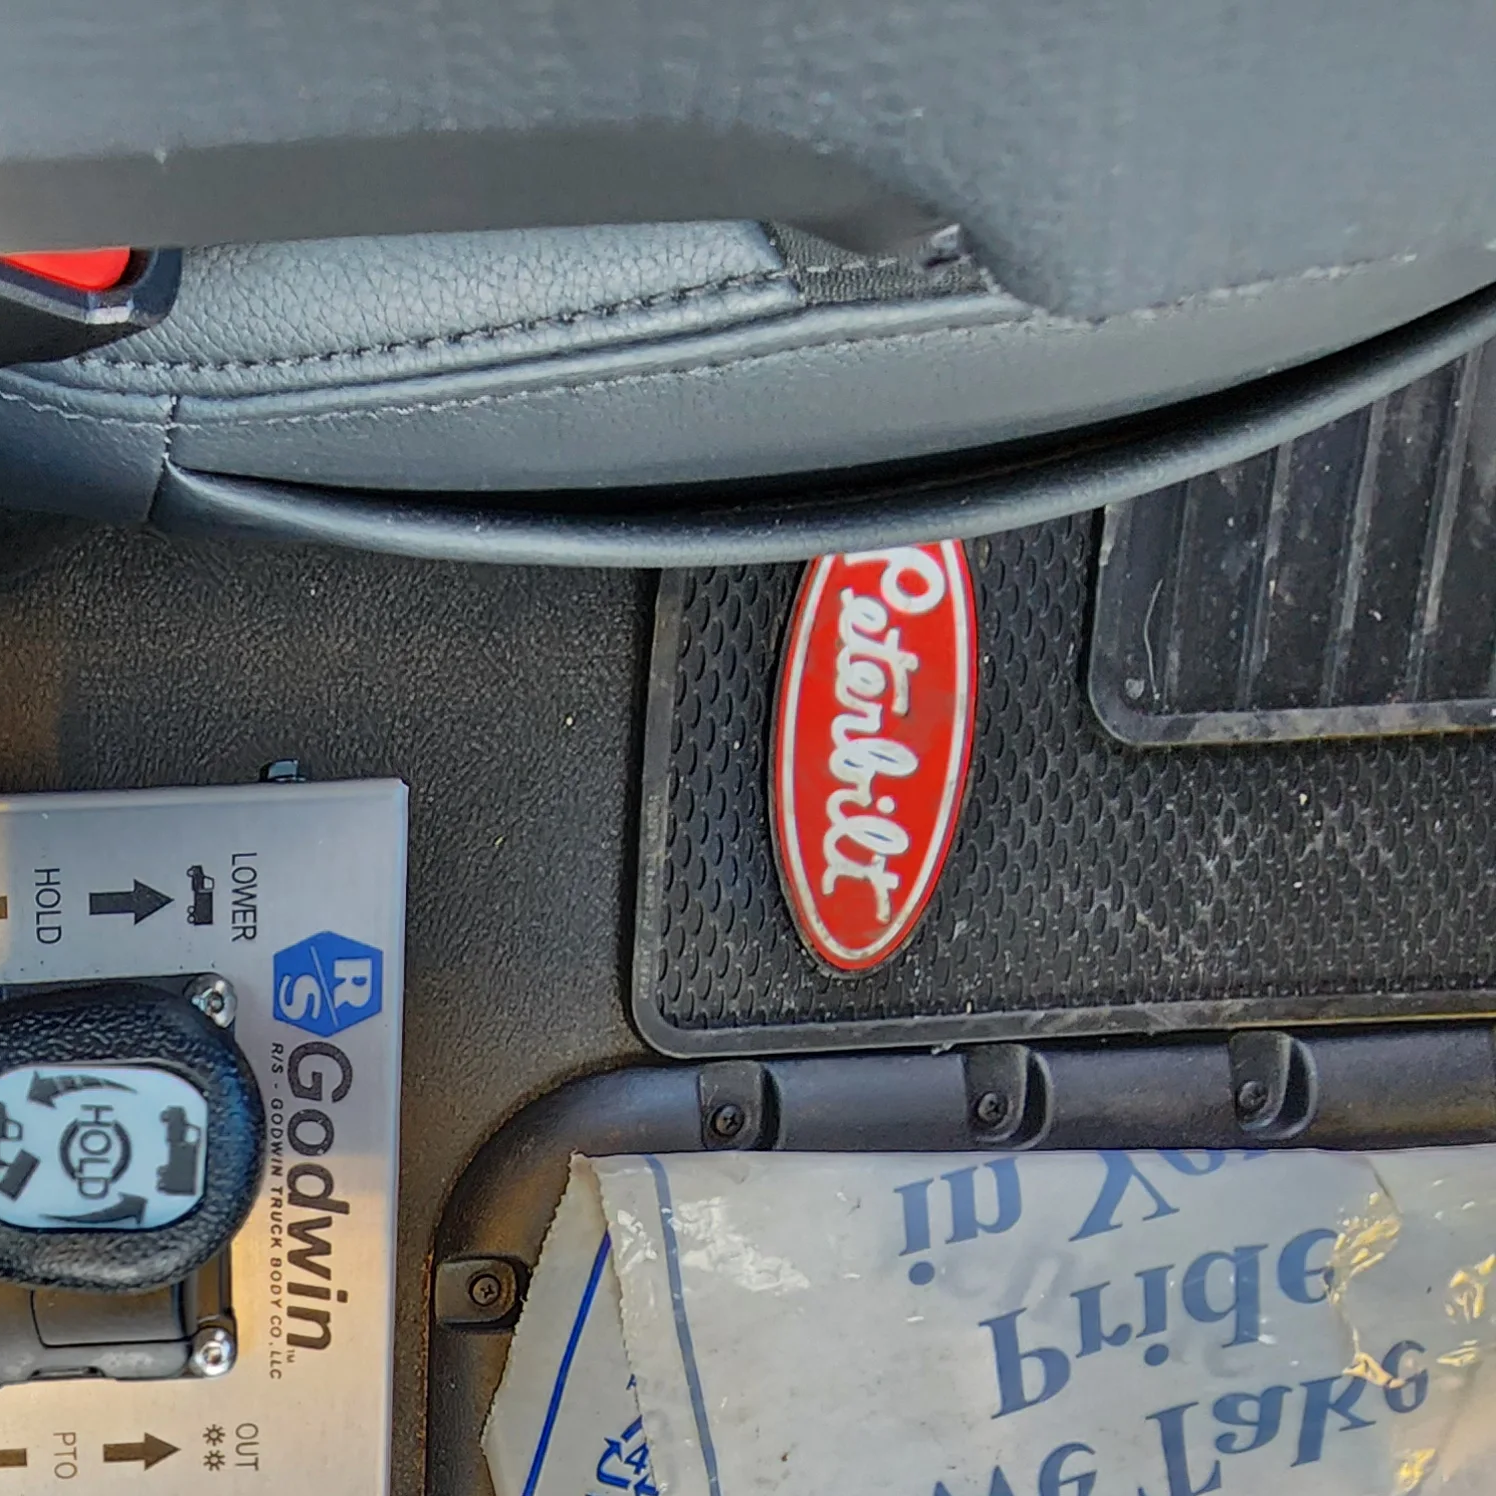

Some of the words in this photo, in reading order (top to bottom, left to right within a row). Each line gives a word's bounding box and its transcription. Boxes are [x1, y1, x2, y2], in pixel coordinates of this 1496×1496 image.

[822, 548, 946, 923] Peterbilt
[34, 867, 62, 945] HOLD
[231, 852, 257, 942] LOWER
[271, 1042, 284, 1074] R/S
[76, 1104, 109, 1200] HOLD
[271, 1098, 283, 1177] GODWIN
[270, 1186, 283, 1249] TRUCK
[287, 1041, 353, 1351] Godwin
[270, 1257, 282, 1308] BODY
[269, 1350, 282, 1379] LLC
[54, 1431, 78, 1480] PTO
[235, 1422, 259, 1471] OUT
